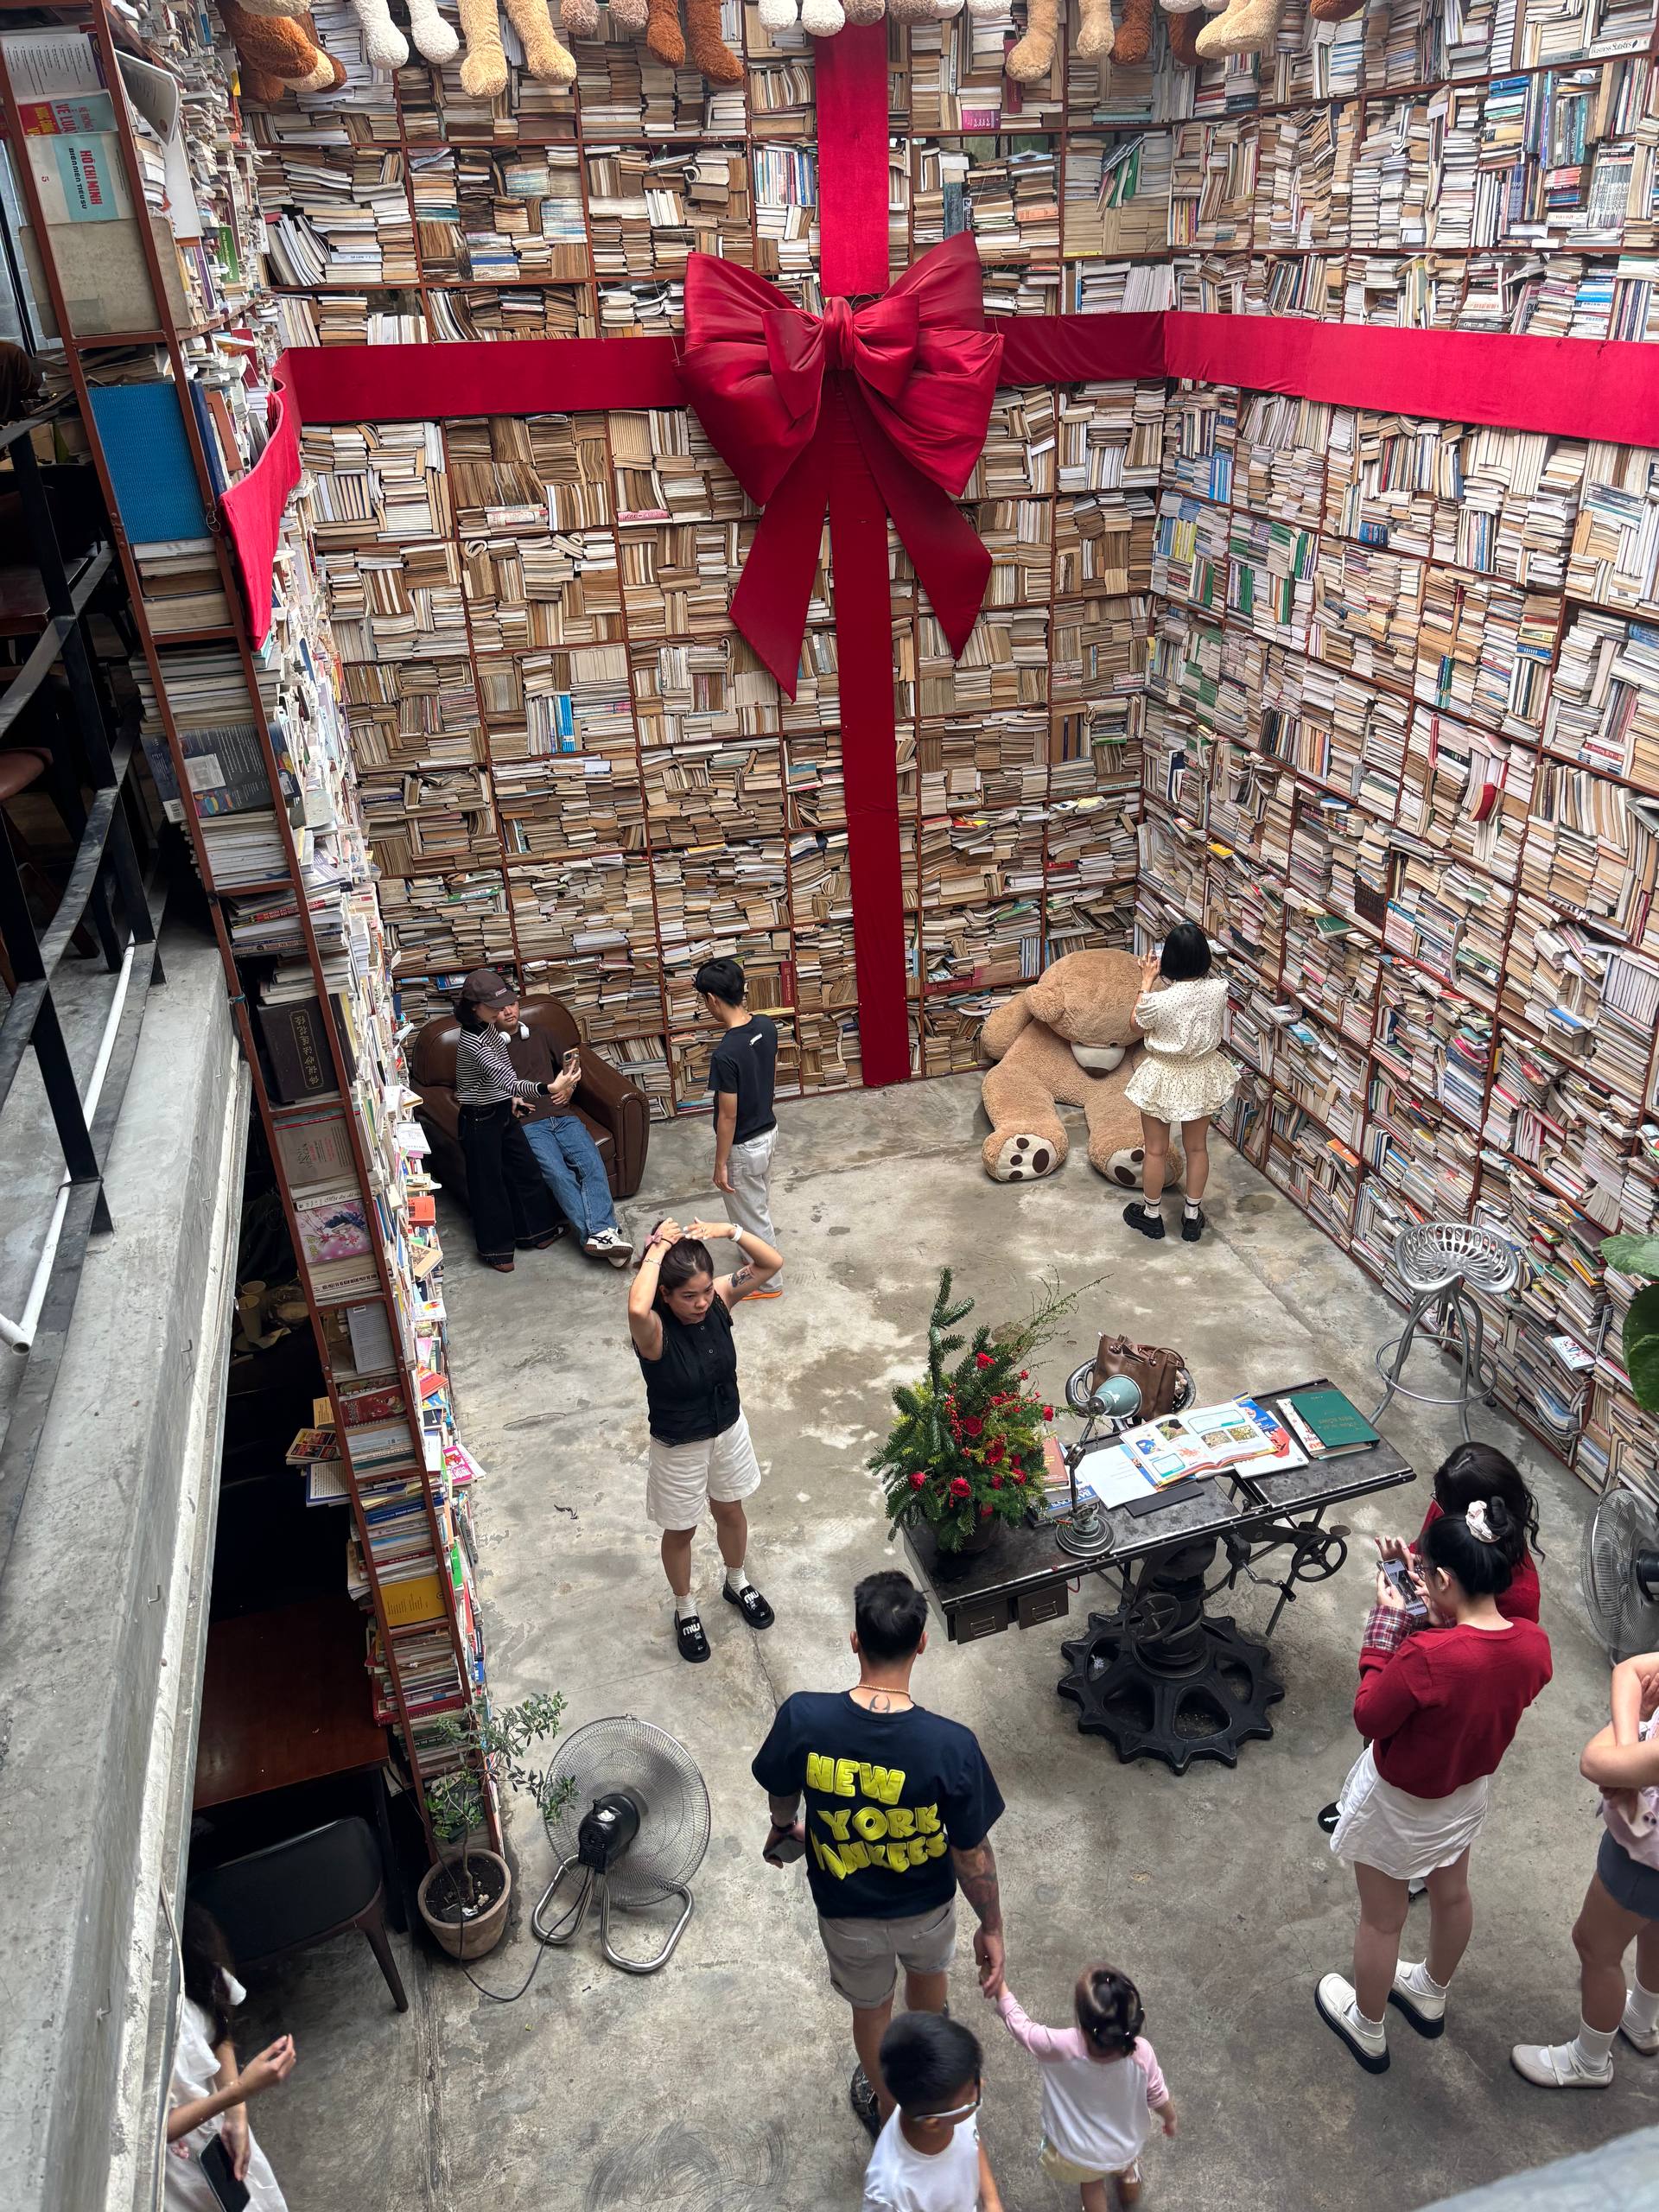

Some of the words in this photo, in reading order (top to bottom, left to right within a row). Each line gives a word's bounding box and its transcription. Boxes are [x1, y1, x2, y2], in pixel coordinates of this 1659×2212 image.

[86, 181, 103, 205] MINH
[806, 1752, 906, 1805] NEW
[817, 1802, 941, 1841] YORK
